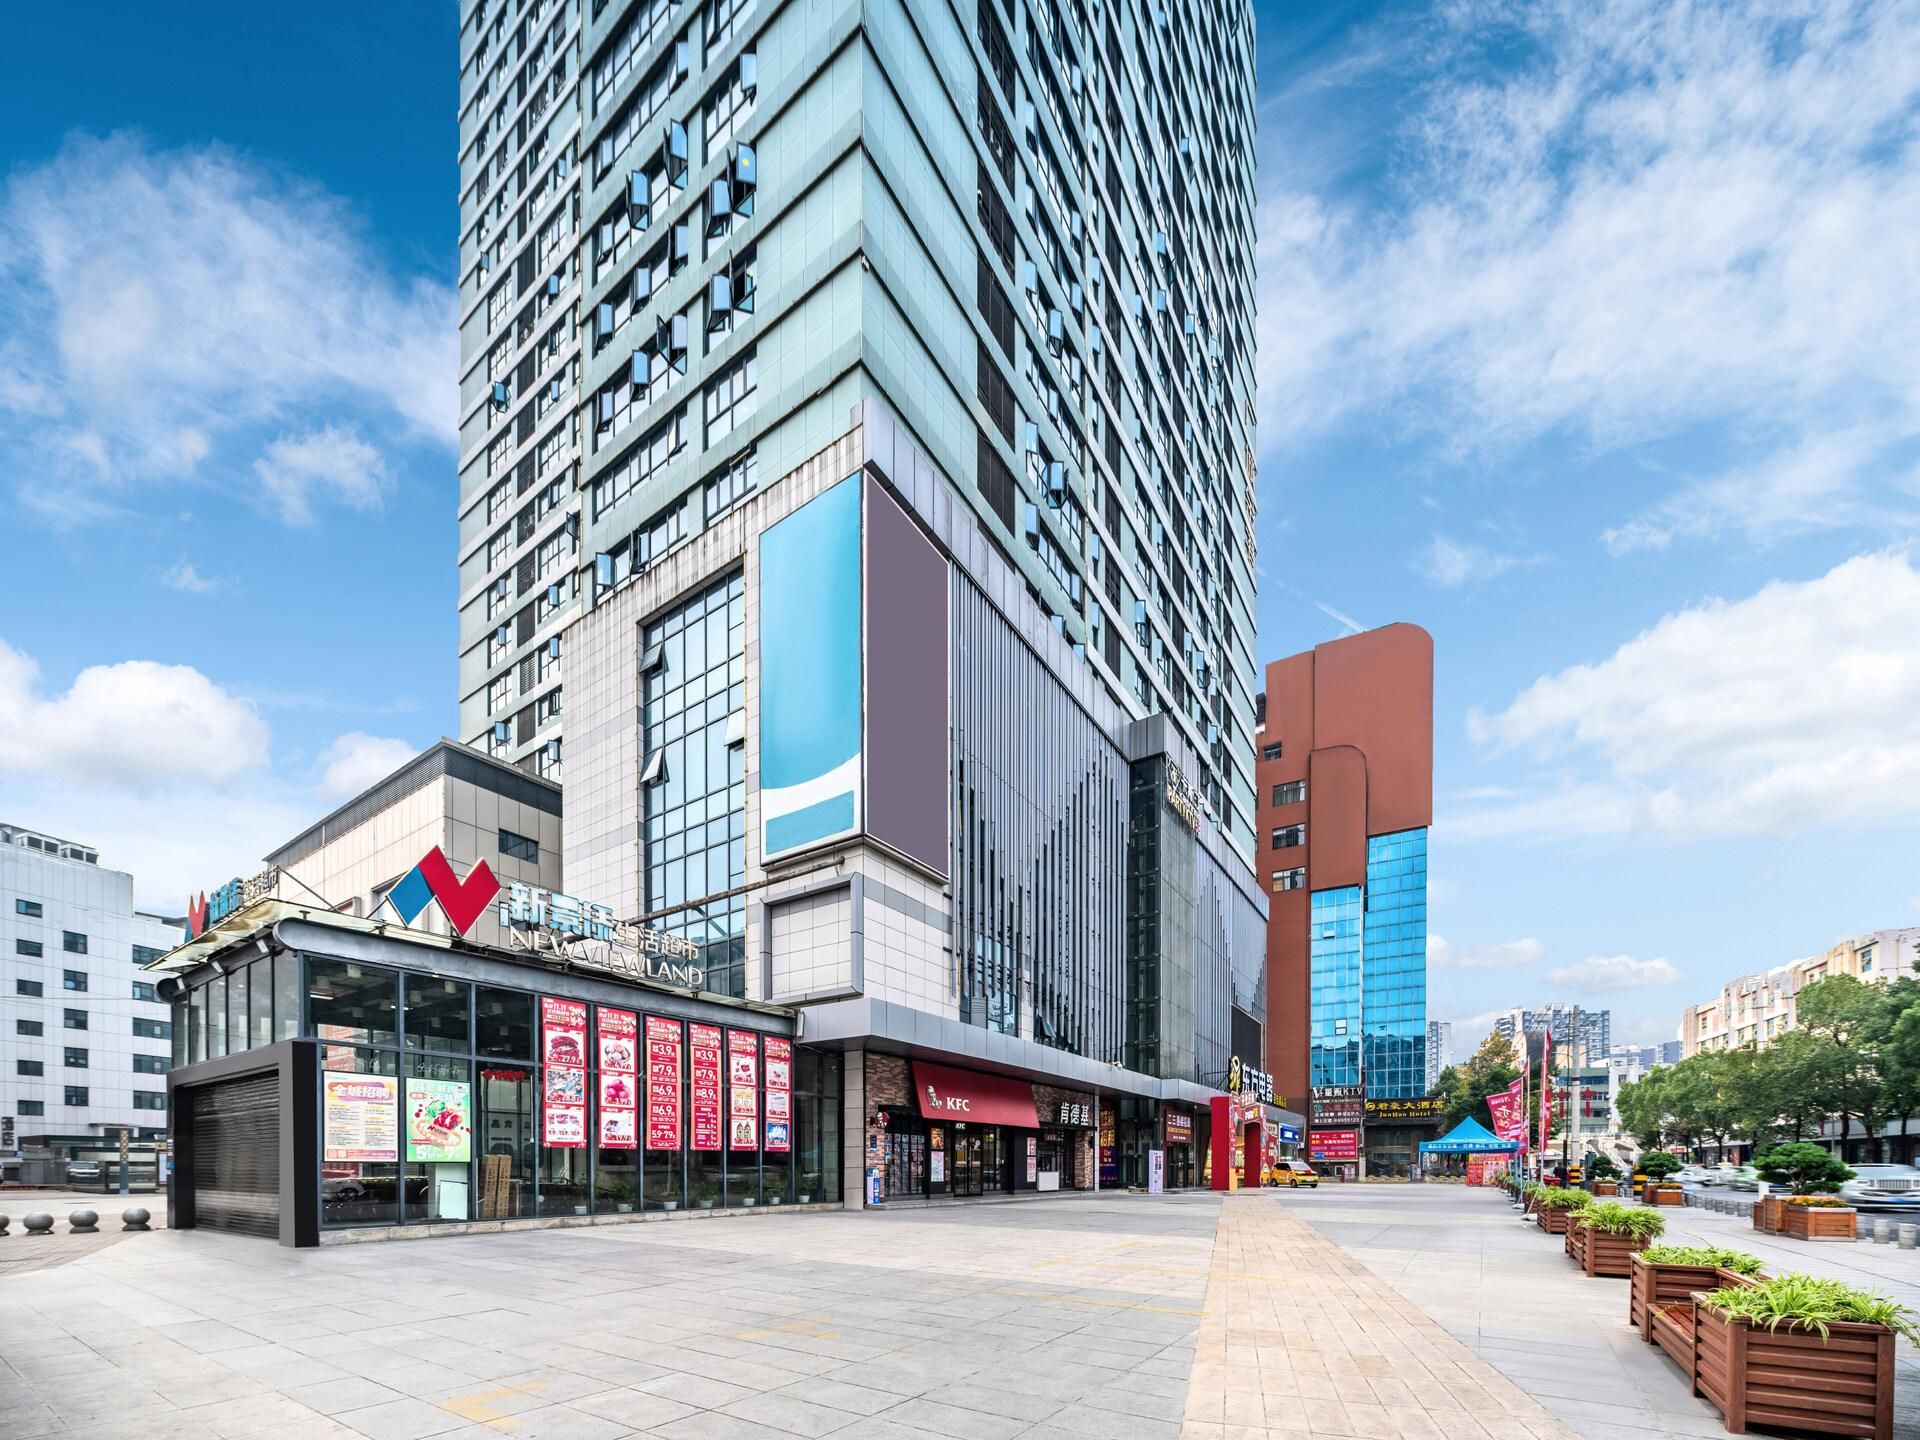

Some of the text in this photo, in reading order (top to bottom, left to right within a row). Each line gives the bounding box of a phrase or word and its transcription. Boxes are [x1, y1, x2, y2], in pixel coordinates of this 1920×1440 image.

[333, 1084, 391, 1099] 全城招聘
[946, 1097, 970, 1112] KFC
[1060, 1101, 1089, 1126] 肯德基
